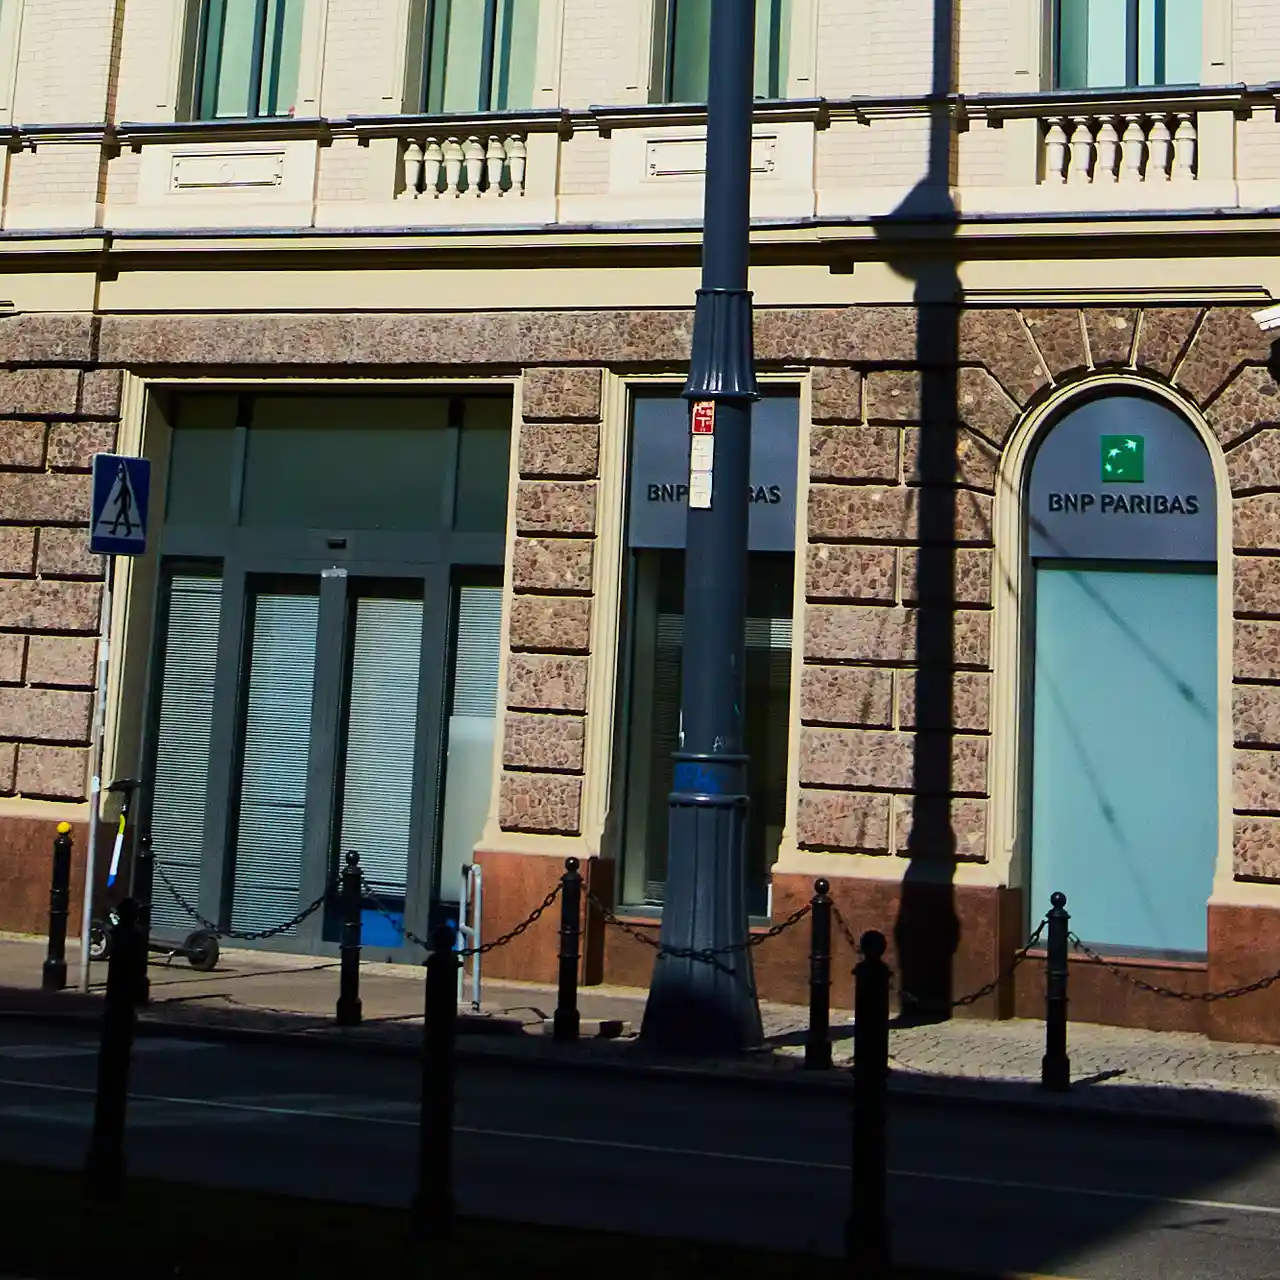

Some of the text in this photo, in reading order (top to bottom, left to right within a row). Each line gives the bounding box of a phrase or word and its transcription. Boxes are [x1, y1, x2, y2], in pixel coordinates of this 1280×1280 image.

[647, 484, 689, 502] BNP
[1048, 493, 1199, 515] BNP PARIBAS
